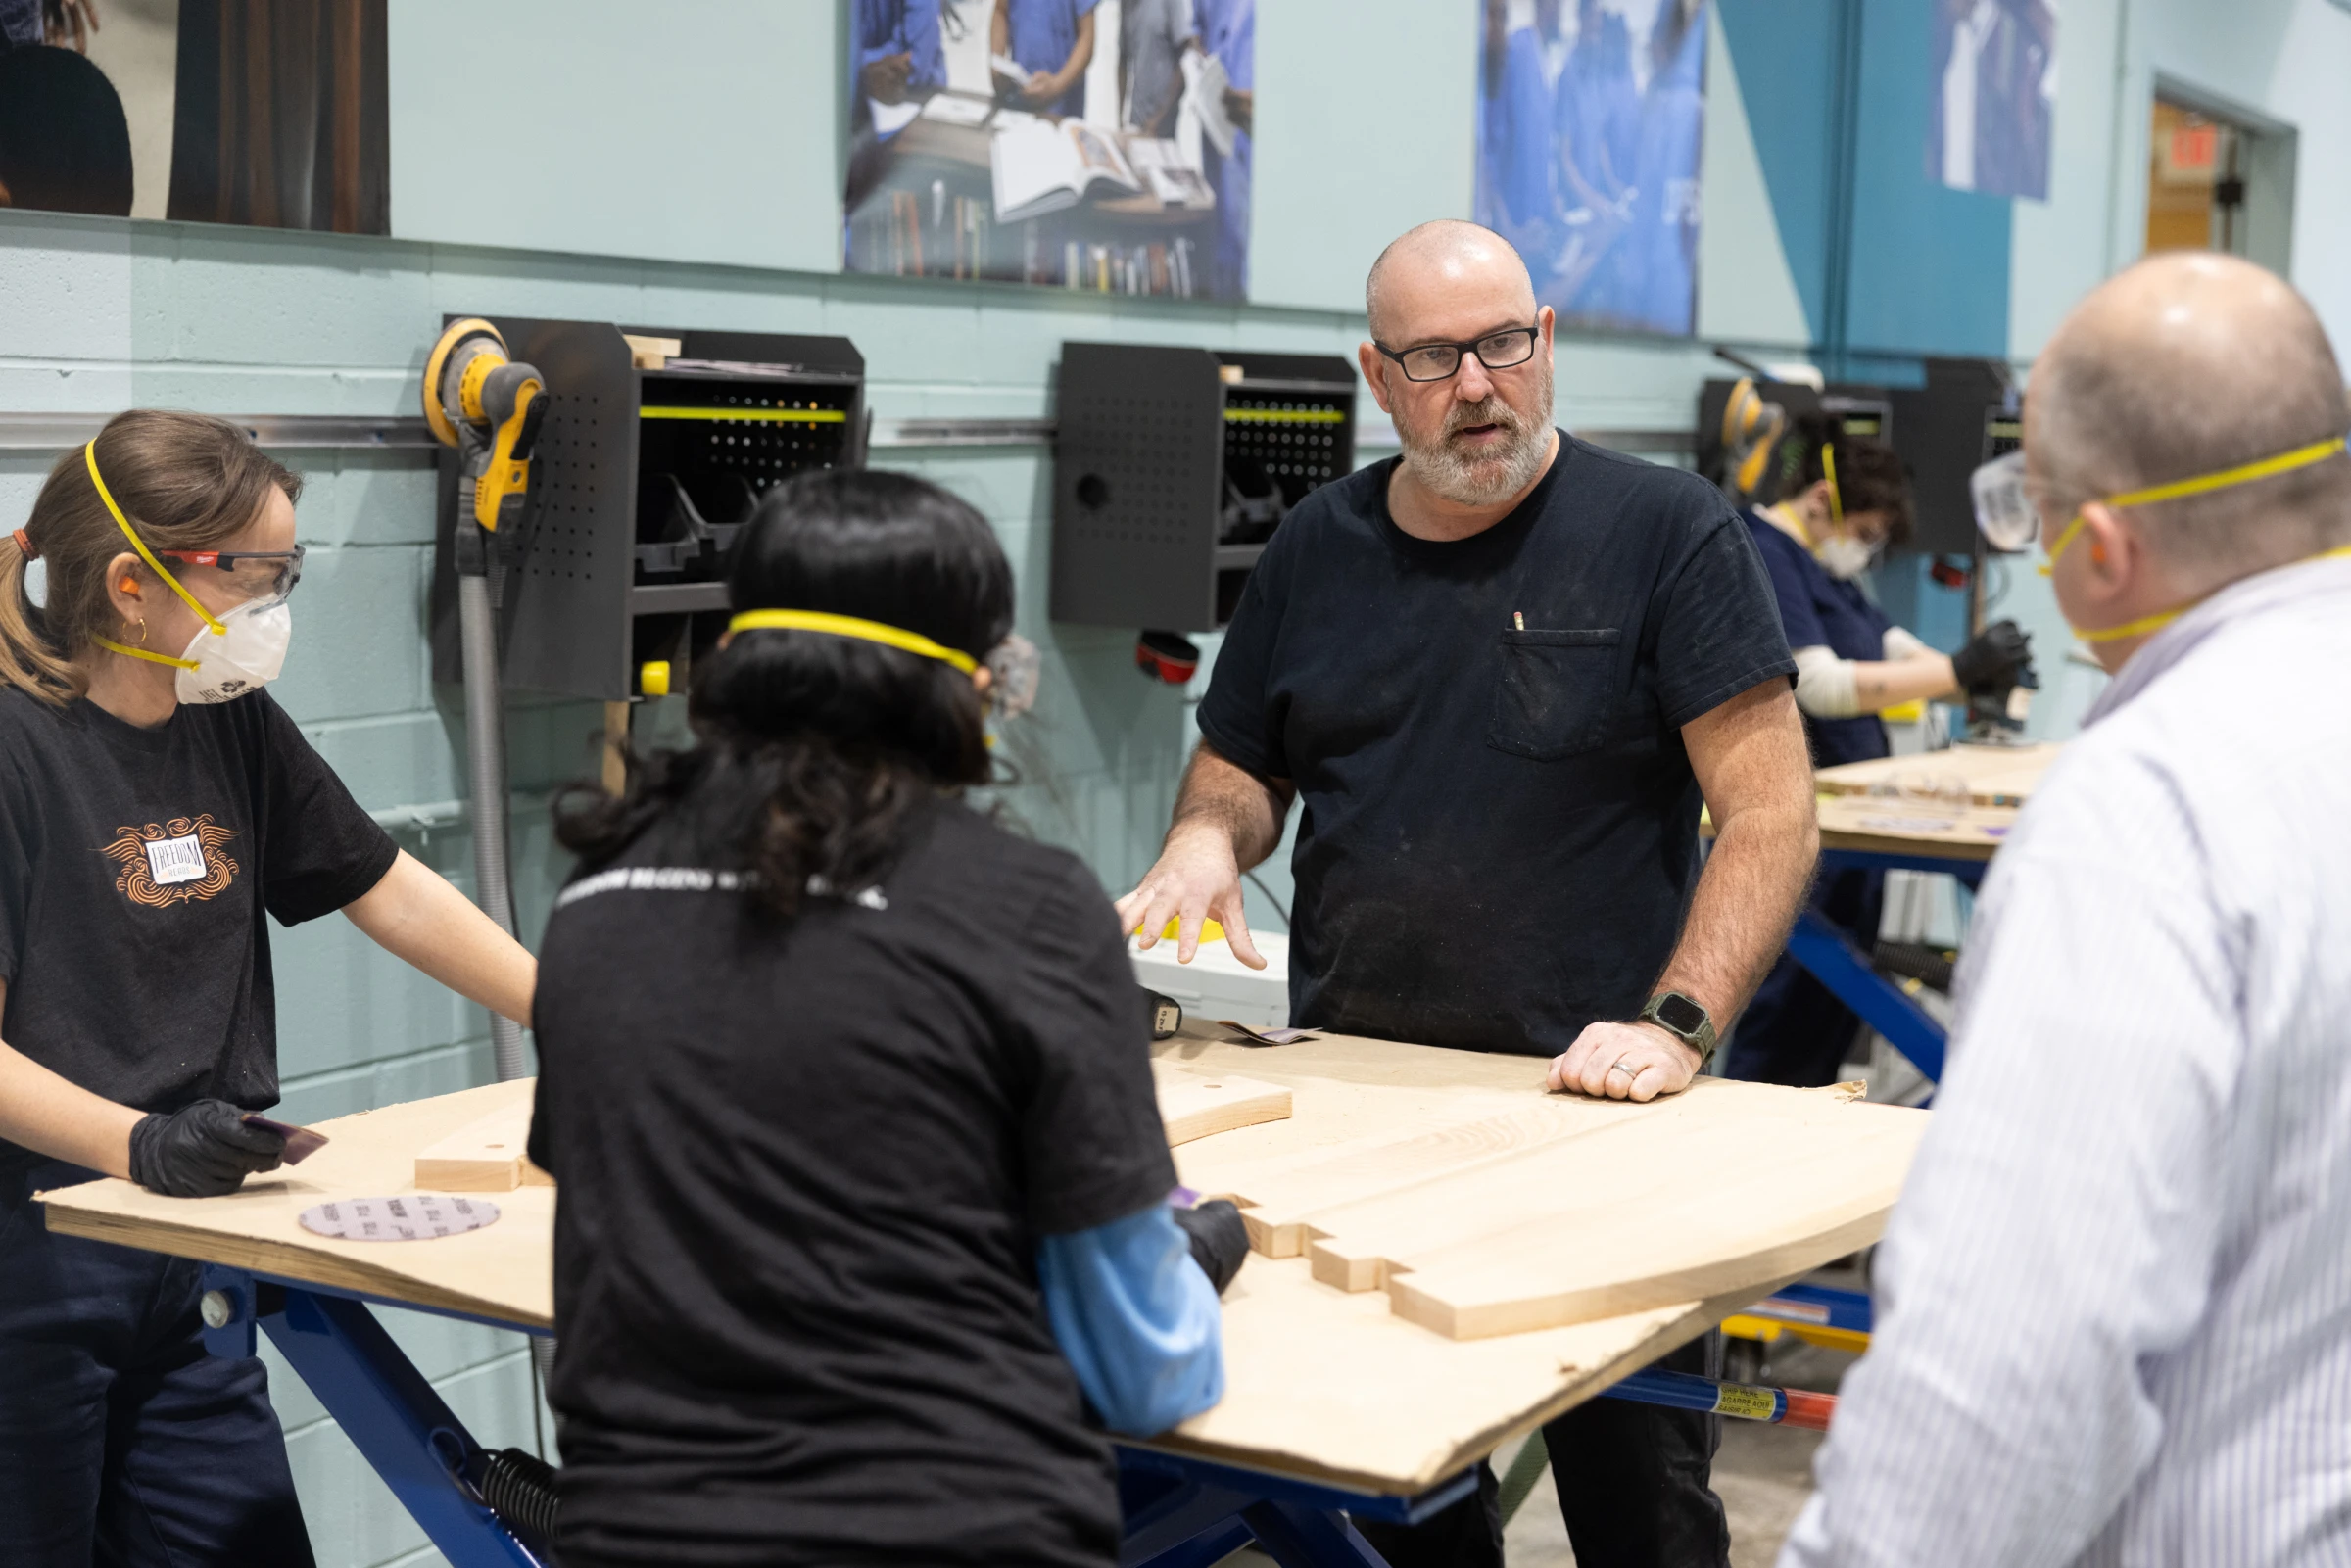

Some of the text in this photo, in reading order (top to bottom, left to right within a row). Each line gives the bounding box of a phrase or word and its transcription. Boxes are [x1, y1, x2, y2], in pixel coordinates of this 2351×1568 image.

[151, 841, 201, 874] FREEDOM
[168, 867, 190, 877] READS
[1721, 1396, 1751, 1406] AGARRE
